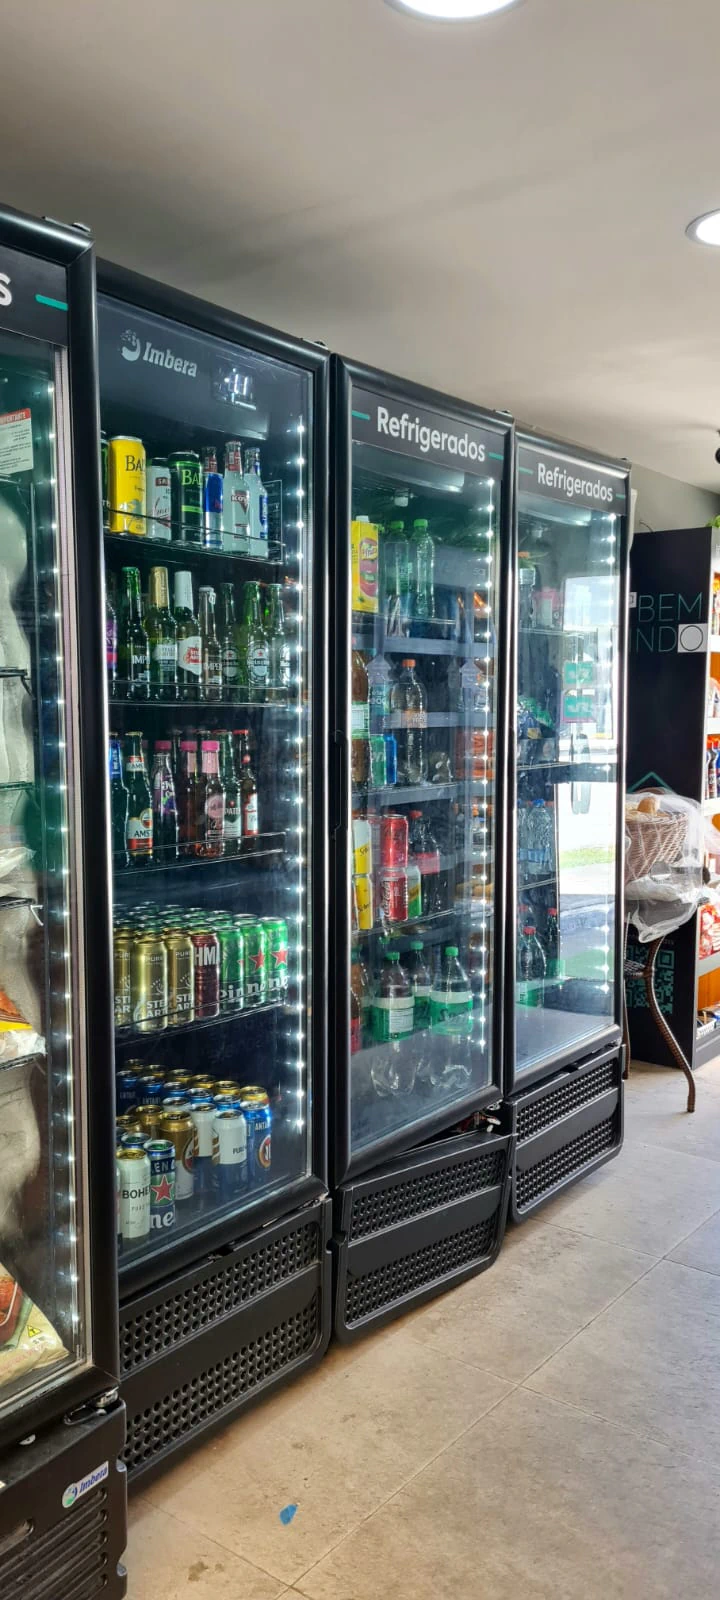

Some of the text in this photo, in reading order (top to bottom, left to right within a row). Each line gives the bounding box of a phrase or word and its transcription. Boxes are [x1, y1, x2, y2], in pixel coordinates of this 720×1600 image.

[143, 342, 198, 378] Imbera
[376, 406, 486, 463] Refrigerados
[537, 463, 614, 502] Refrigerados
[638, 591, 703, 622] BEM
[79, 1467, 108, 1493] Imbera
